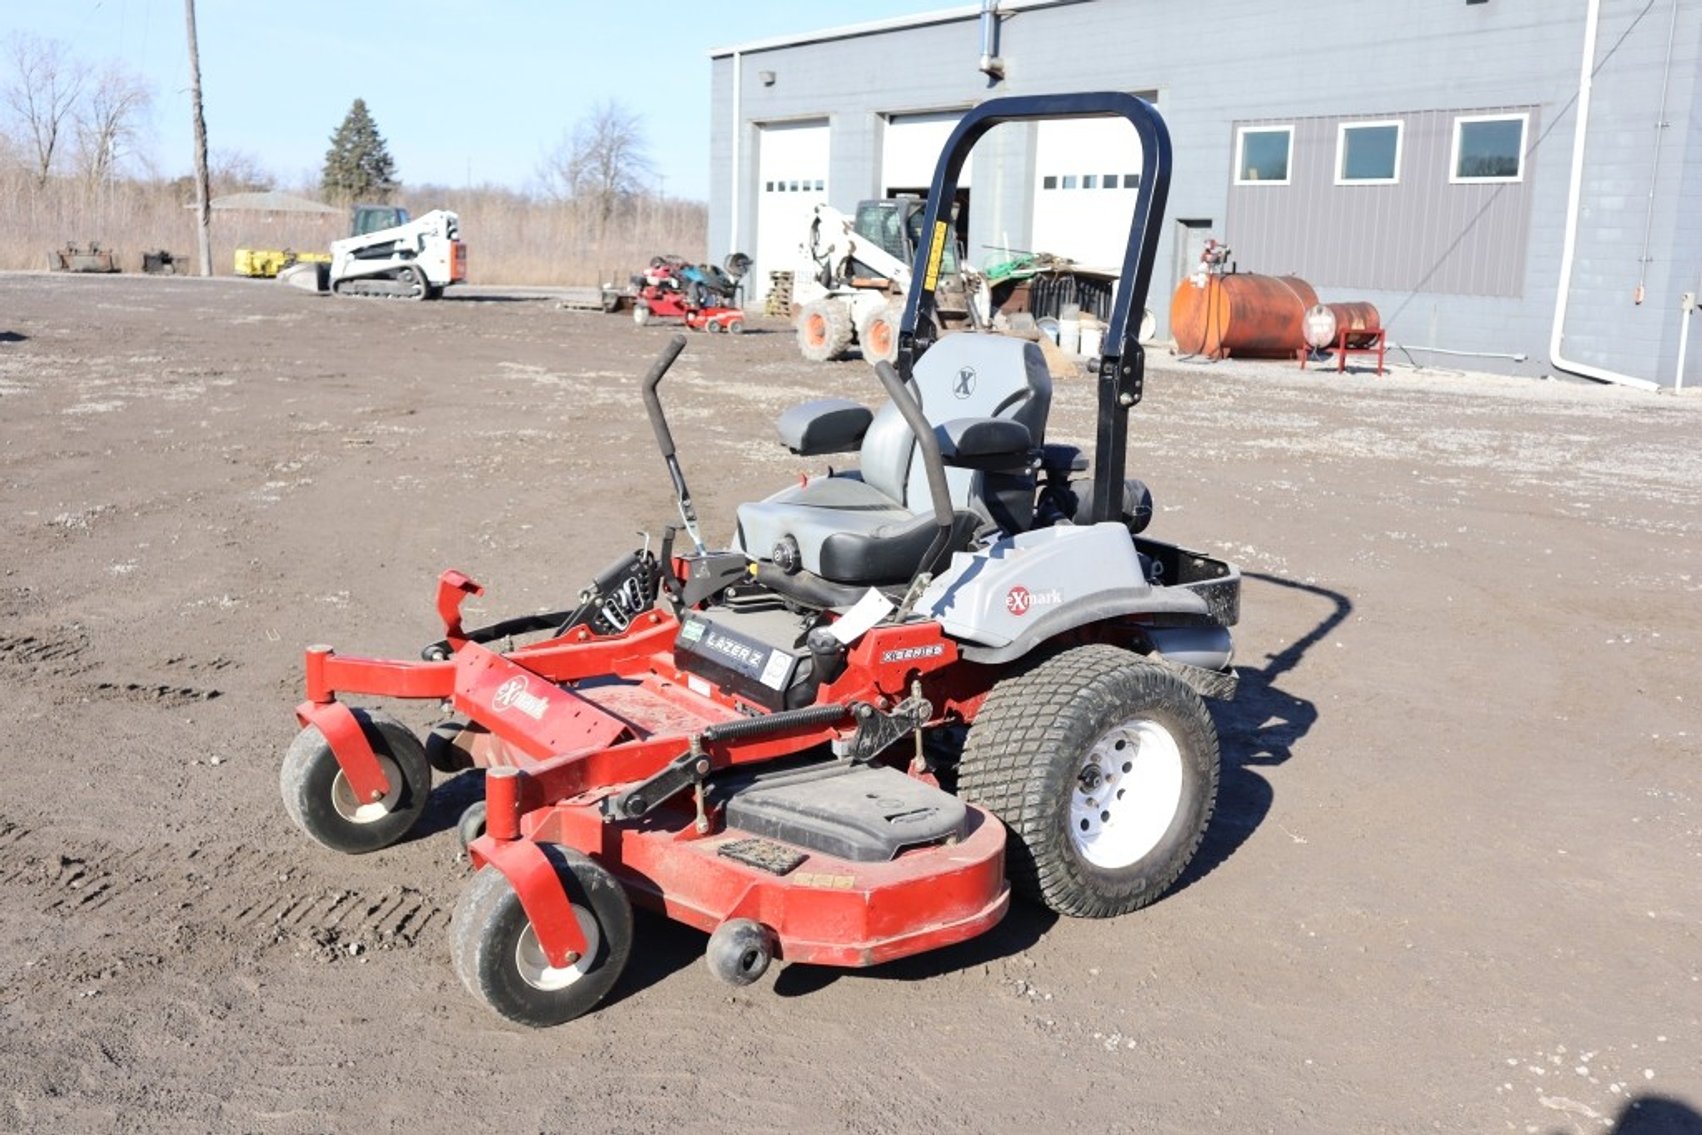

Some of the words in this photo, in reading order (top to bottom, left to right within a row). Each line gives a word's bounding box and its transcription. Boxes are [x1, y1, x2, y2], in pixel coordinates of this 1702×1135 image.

[955, 369, 974, 396] X
[1005, 588, 1062, 612] eXmark
[705, 632, 751, 663] LAZER
[749, 650, 764, 668] Z
